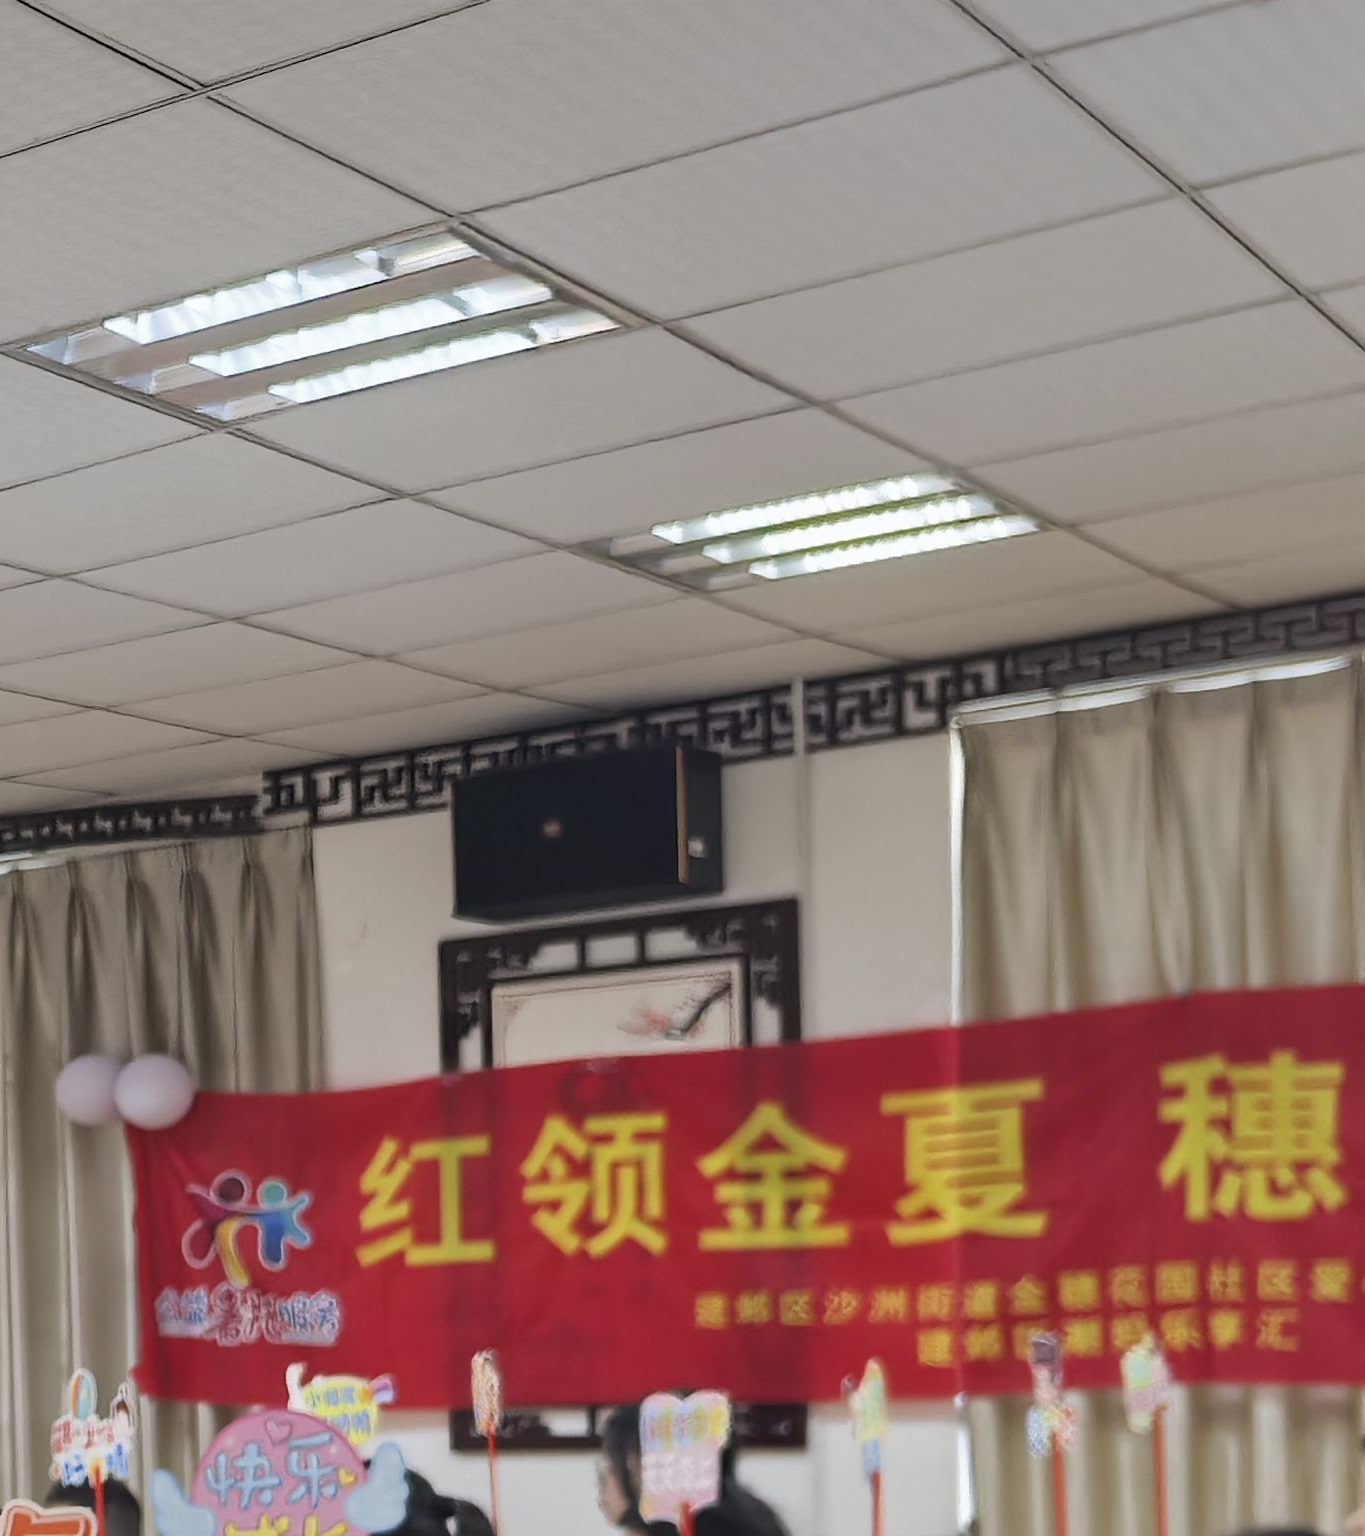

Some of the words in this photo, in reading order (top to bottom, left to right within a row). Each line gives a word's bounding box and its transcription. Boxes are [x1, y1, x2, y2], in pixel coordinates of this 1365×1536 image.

[356, 1078, 1049, 1268] 红领金夏
[1159, 1048, 1346, 1222] 穗
[206, 1431, 342, 1510] 快乐
